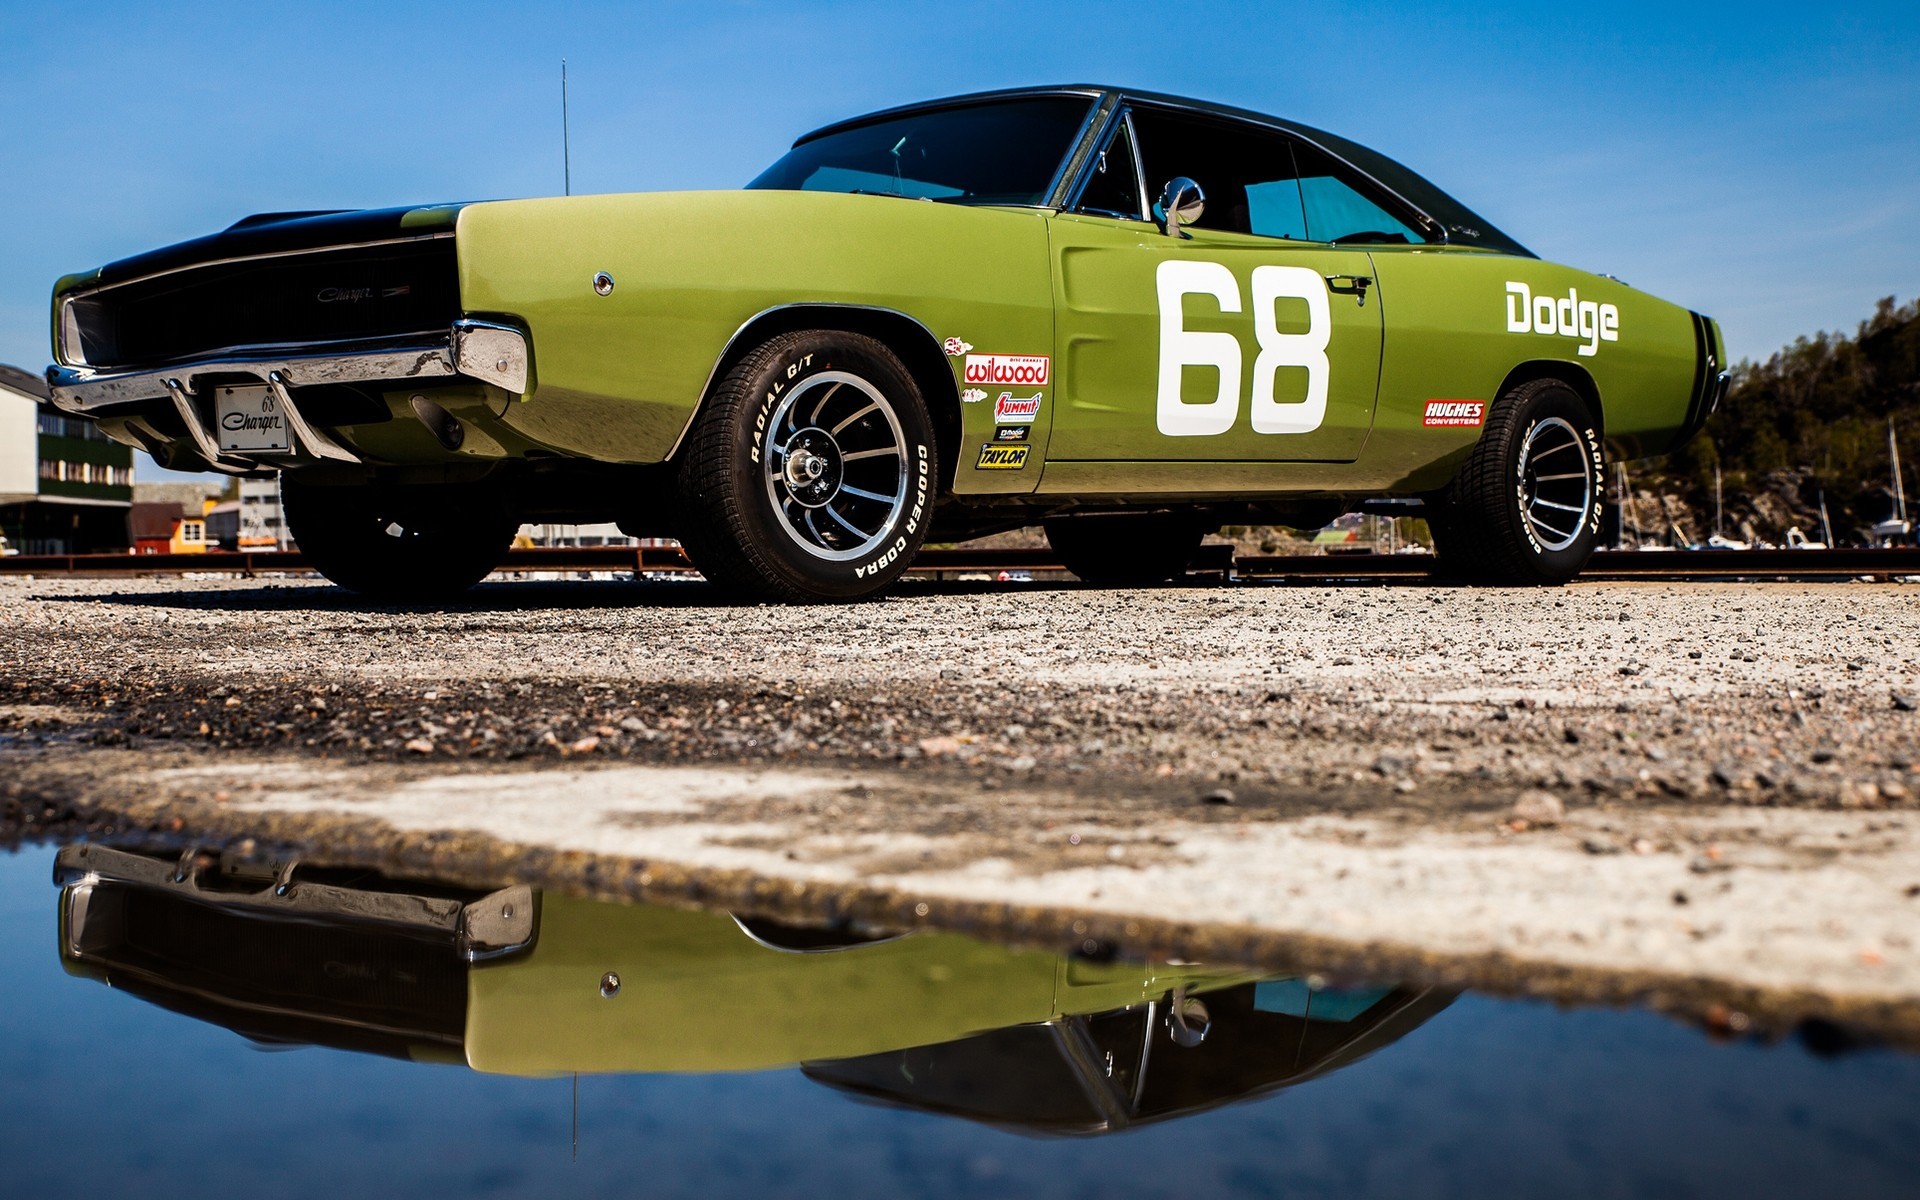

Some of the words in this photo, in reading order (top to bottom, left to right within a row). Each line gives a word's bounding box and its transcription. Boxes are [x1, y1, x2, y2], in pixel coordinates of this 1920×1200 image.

[1505, 281, 1619, 357] Dodge
[1156, 259, 1331, 436] 68
[966, 357, 1048, 383] wilwood
[222, 412, 283, 435] Charger
[262, 395, 275, 412] 68
[751, 382, 784, 464] RADIAL
[787, 353, 814, 379] G/T
[1425, 403, 1484, 417] HUGHES
[981, 450, 1026, 464] TAYLOR
[1585, 428, 1603, 496] RADIAL
[905, 444, 929, 535] COOPER
[855, 536, 907, 578] COBRA
